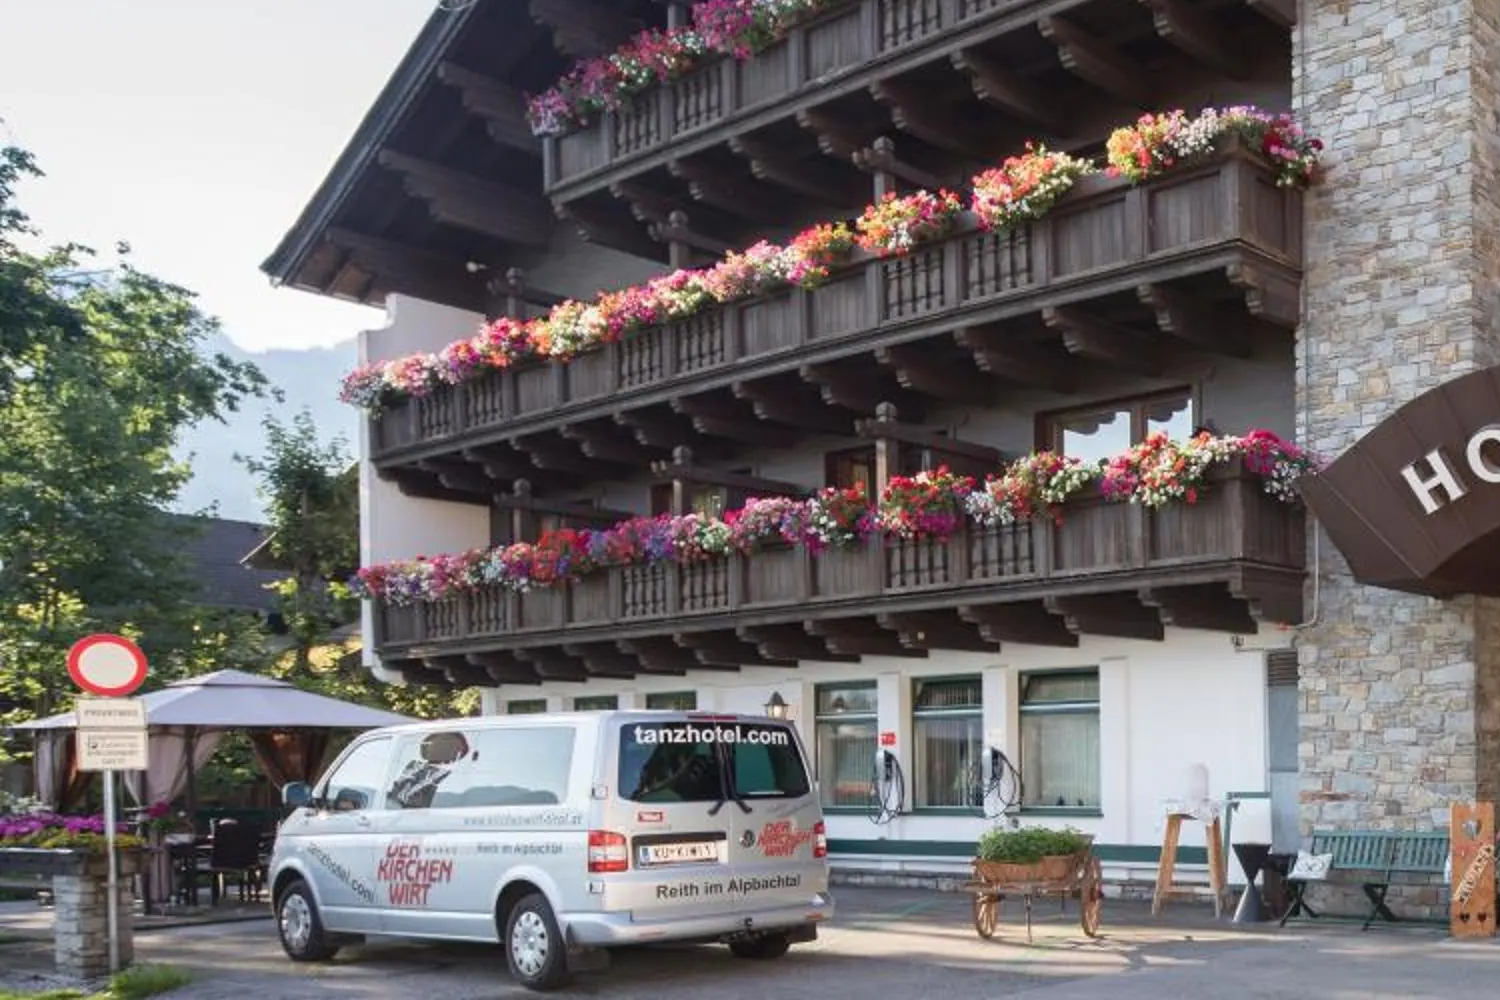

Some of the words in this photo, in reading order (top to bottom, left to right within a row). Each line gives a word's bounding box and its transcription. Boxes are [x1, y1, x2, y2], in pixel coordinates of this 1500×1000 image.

[634, 724, 788, 745] tanzhotel.com
[386, 842, 420, 858] DER
[377, 858, 453, 883] KIRCHEN
[388, 883, 431, 905] WIRT
[655, 883, 699, 898] Reith
[703, 881, 723, 895] im
[727, 874, 801, 894] Alpbachtal
